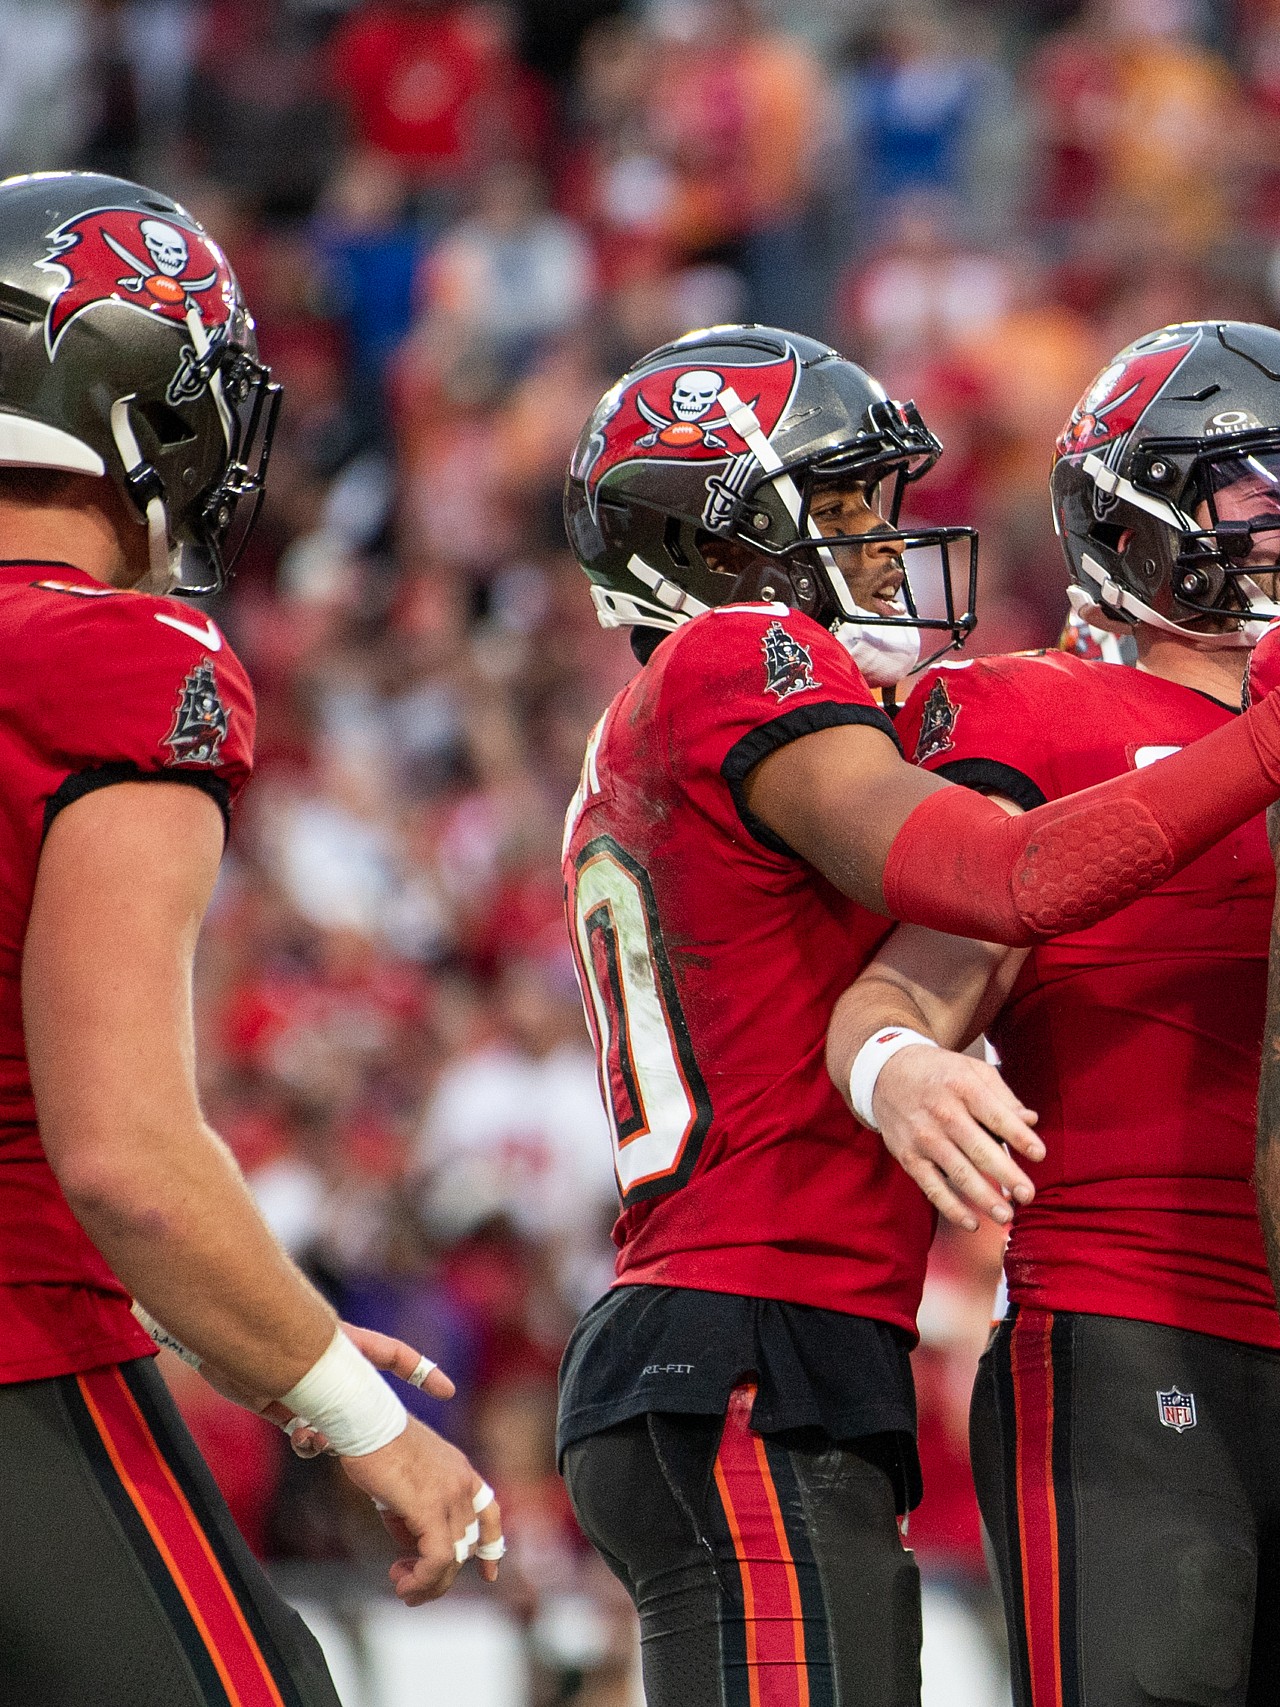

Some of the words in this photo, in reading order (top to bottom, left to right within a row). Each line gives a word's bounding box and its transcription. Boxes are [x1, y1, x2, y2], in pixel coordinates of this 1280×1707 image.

[1206, 421, 1257, 436] OAKLEY
[572, 833, 714, 1208] 0
[640, 1364, 695, 1377] RI-FIT
[1165, 1407, 1192, 1424] NFL
